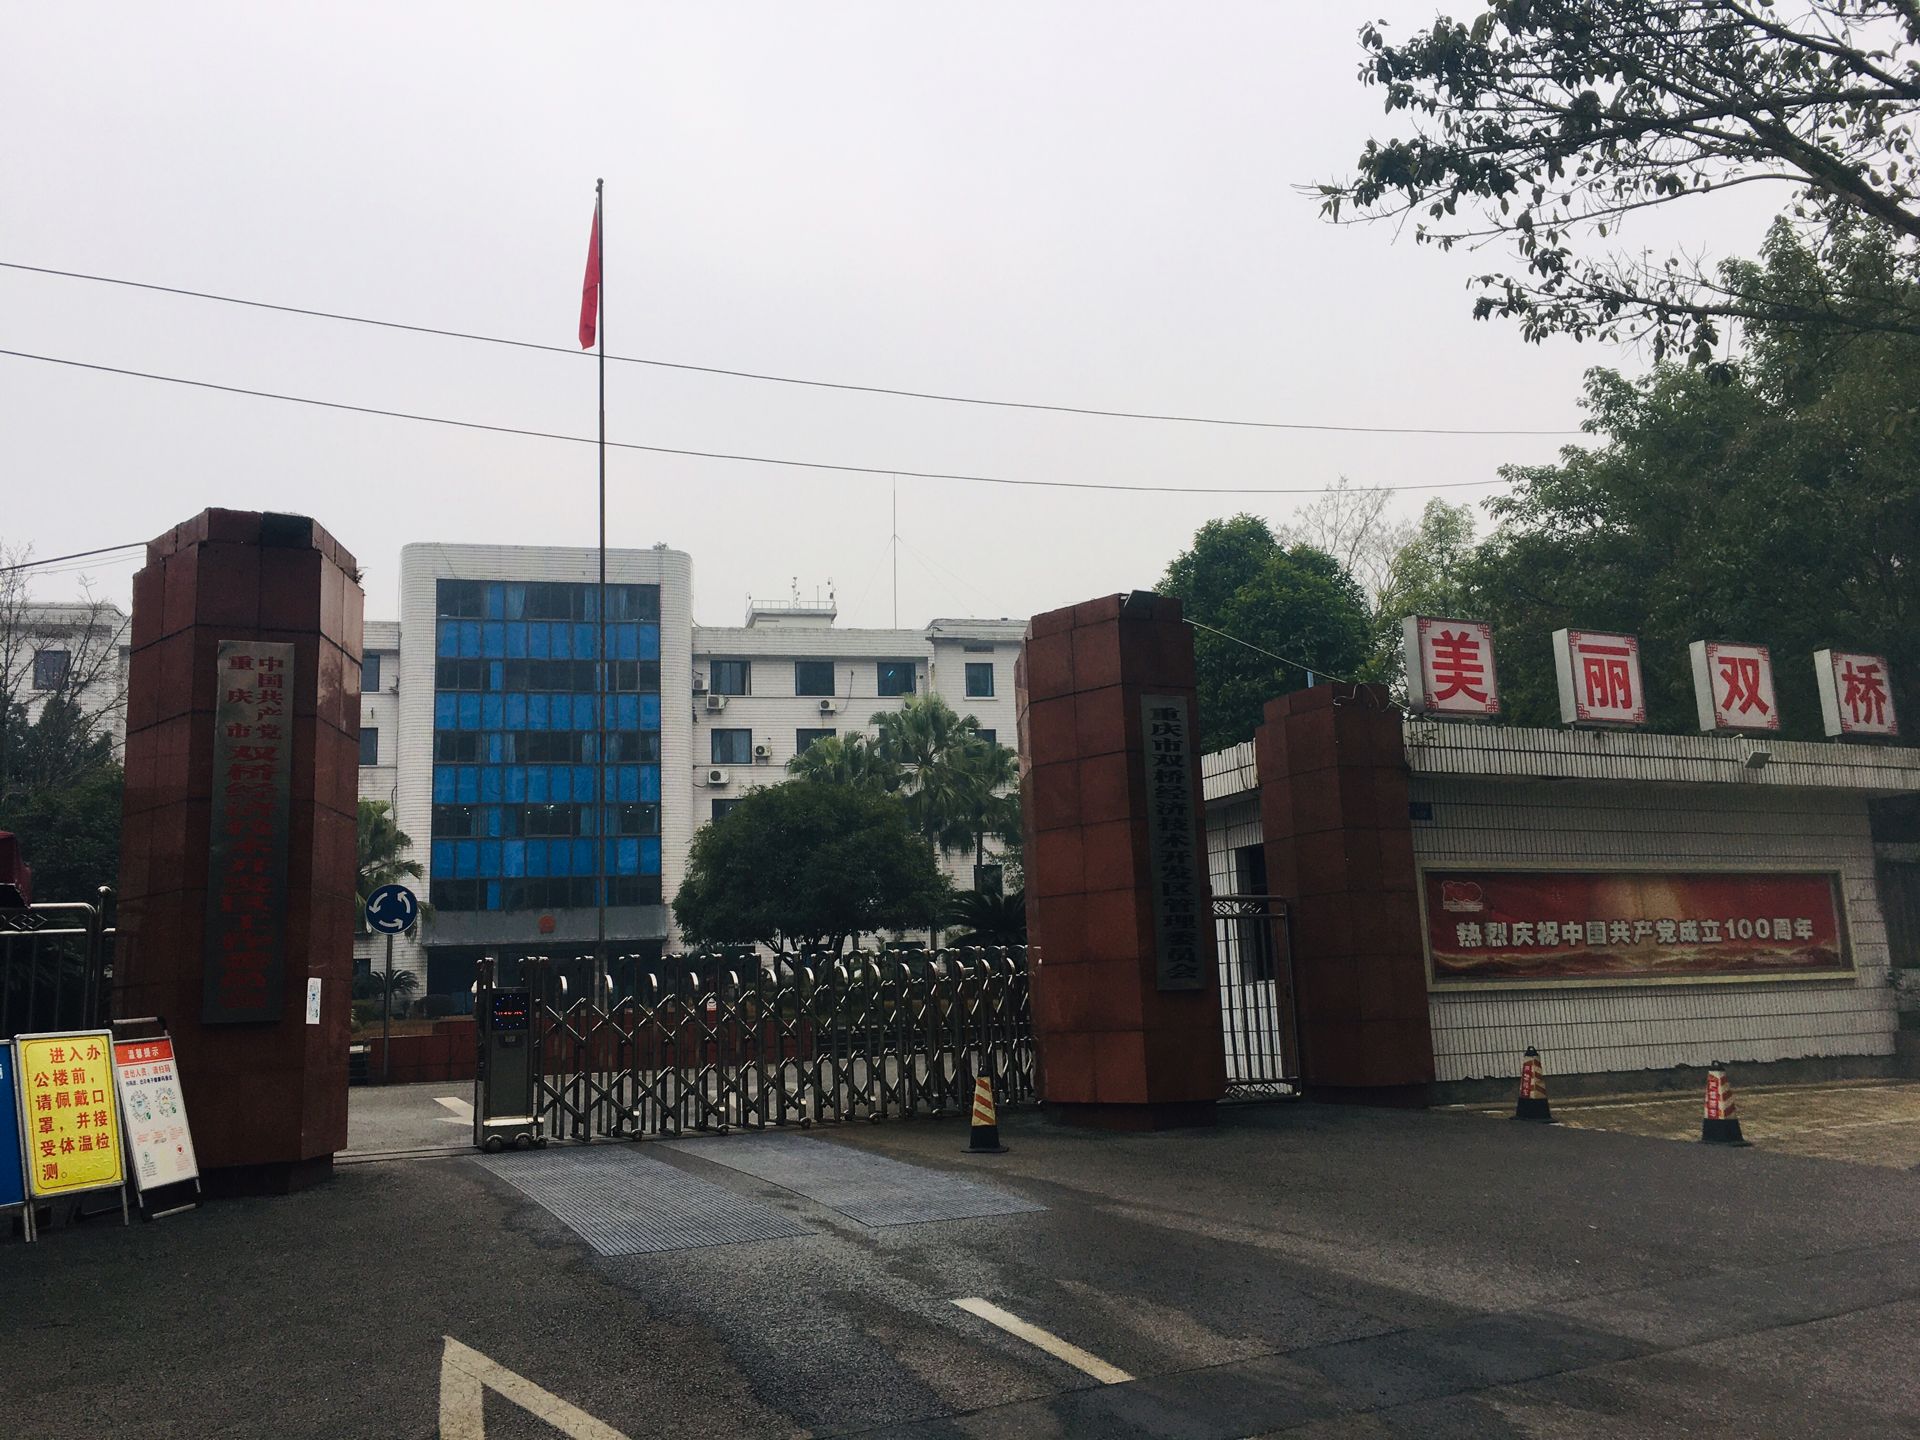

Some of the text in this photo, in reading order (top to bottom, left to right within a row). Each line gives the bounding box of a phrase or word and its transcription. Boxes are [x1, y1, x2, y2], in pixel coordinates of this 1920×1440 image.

[225, 655, 255, 738] 重庆市
[256, 656, 284, 740] 中国共产党
[1431, 630, 1887, 725] 美丽双桥
[1149, 707, 1199, 979] 重庆市双桥经济技术开发区管理委员会
[1456, 918, 1814, 948] 热烈庆祝中国共产党成立100周年
[49, 1045, 101, 1064] 进入办
[35, 1089, 105, 1111] 请佩戴口
[40, 1132, 110, 1158] 受体温检
